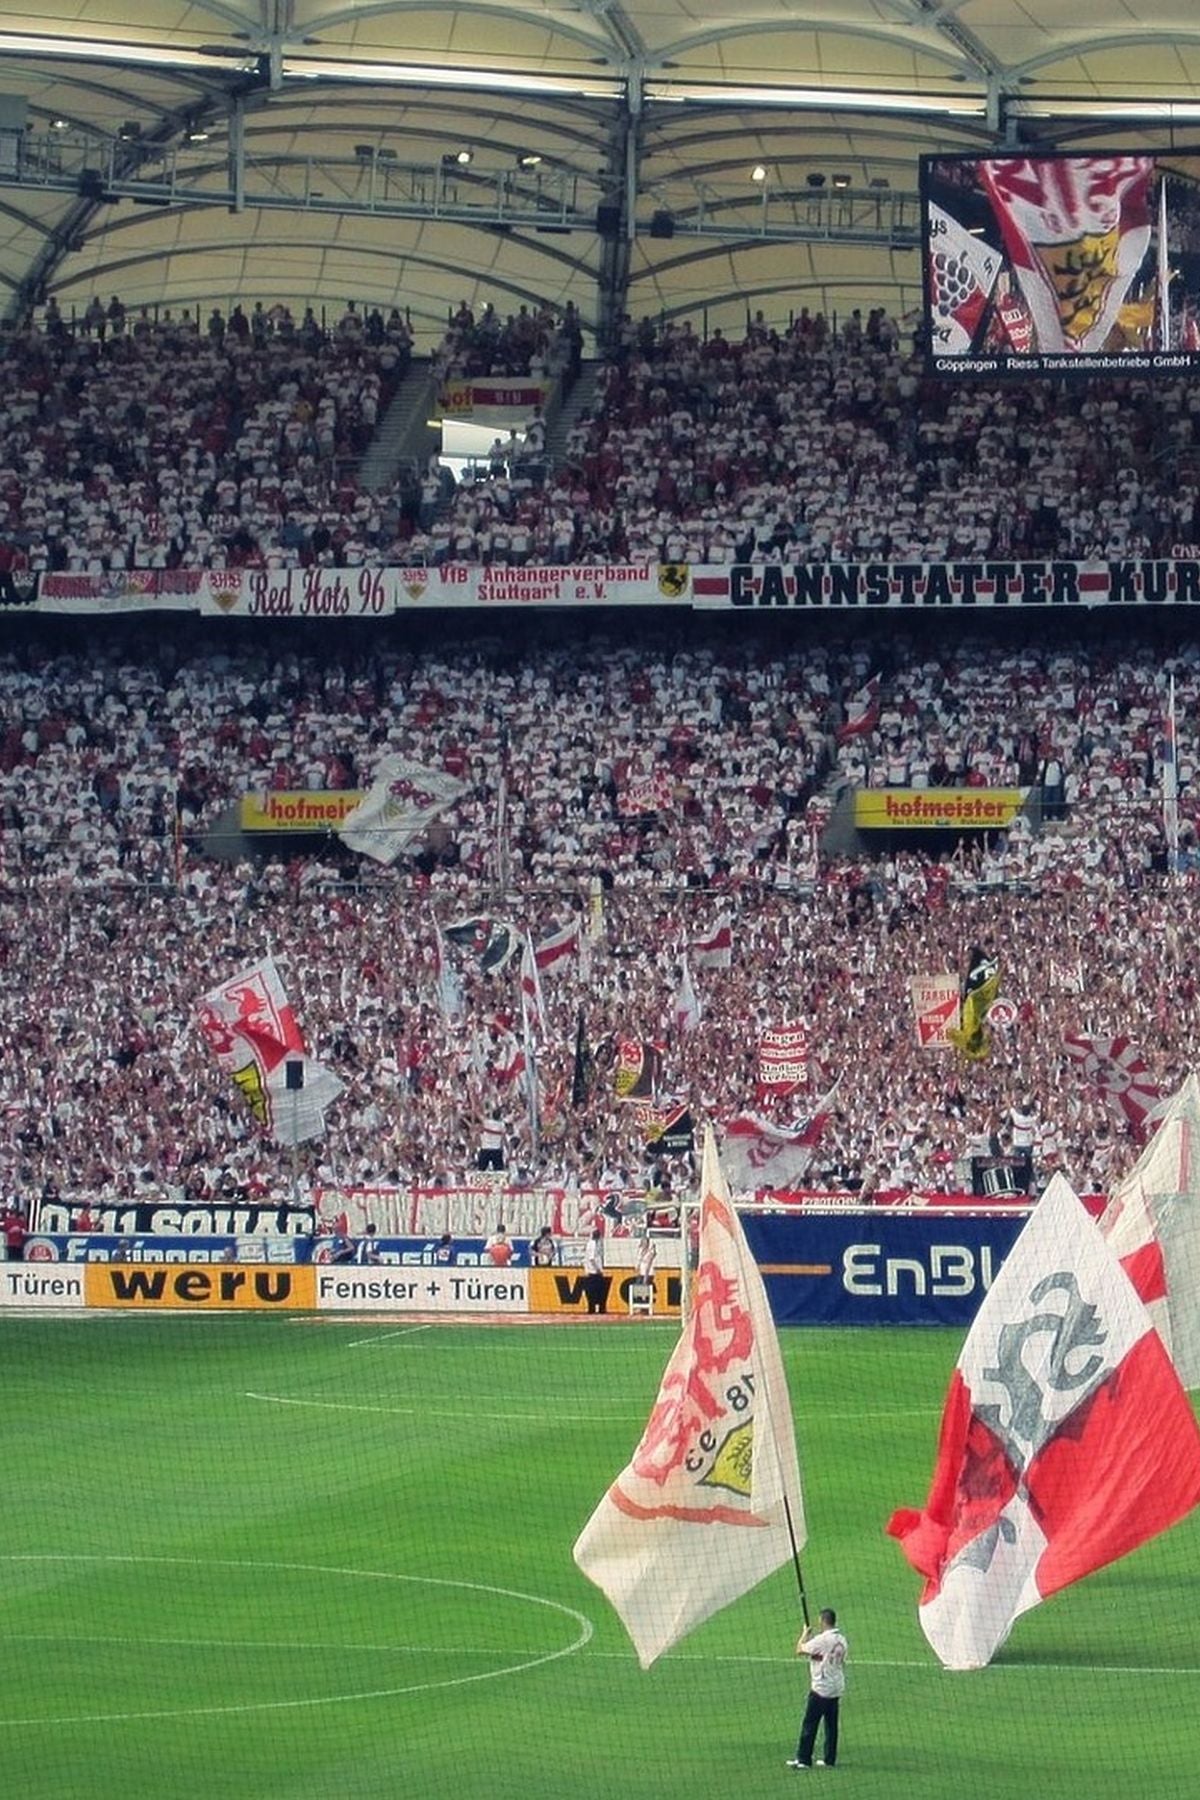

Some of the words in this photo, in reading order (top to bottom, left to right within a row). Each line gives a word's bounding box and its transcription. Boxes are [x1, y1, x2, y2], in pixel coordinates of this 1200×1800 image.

[936, 359, 997, 372] Göppingen
[1007, 358, 1039, 369] Riess
[1042, 356, 1150, 368] Tankstellenbetriebe
[1153, 355, 1190, 366] GmbH
[439, 568, 468, 584] VfB
[484, 566, 649, 584] Anhängerverband
[730, 563, 1080, 606] CANNSTATTER
[249, 569, 293, 615] Red
[301, 569, 350, 615] Hots
[358, 567, 385, 614] 96
[478, 584, 560, 601] Stuttgart
[270, 797, 360, 819] hofmei
[886, 796, 1006, 817] hofmeister
[7, 1273, 80, 1295] Türen
[111, 1271, 290, 1302] weru
[320, 1277, 417, 1299] Fenster
[427, 1283, 440, 1295] +
[450, 1277, 524, 1300] Türen
[554, 1276, 682, 1306] wer
